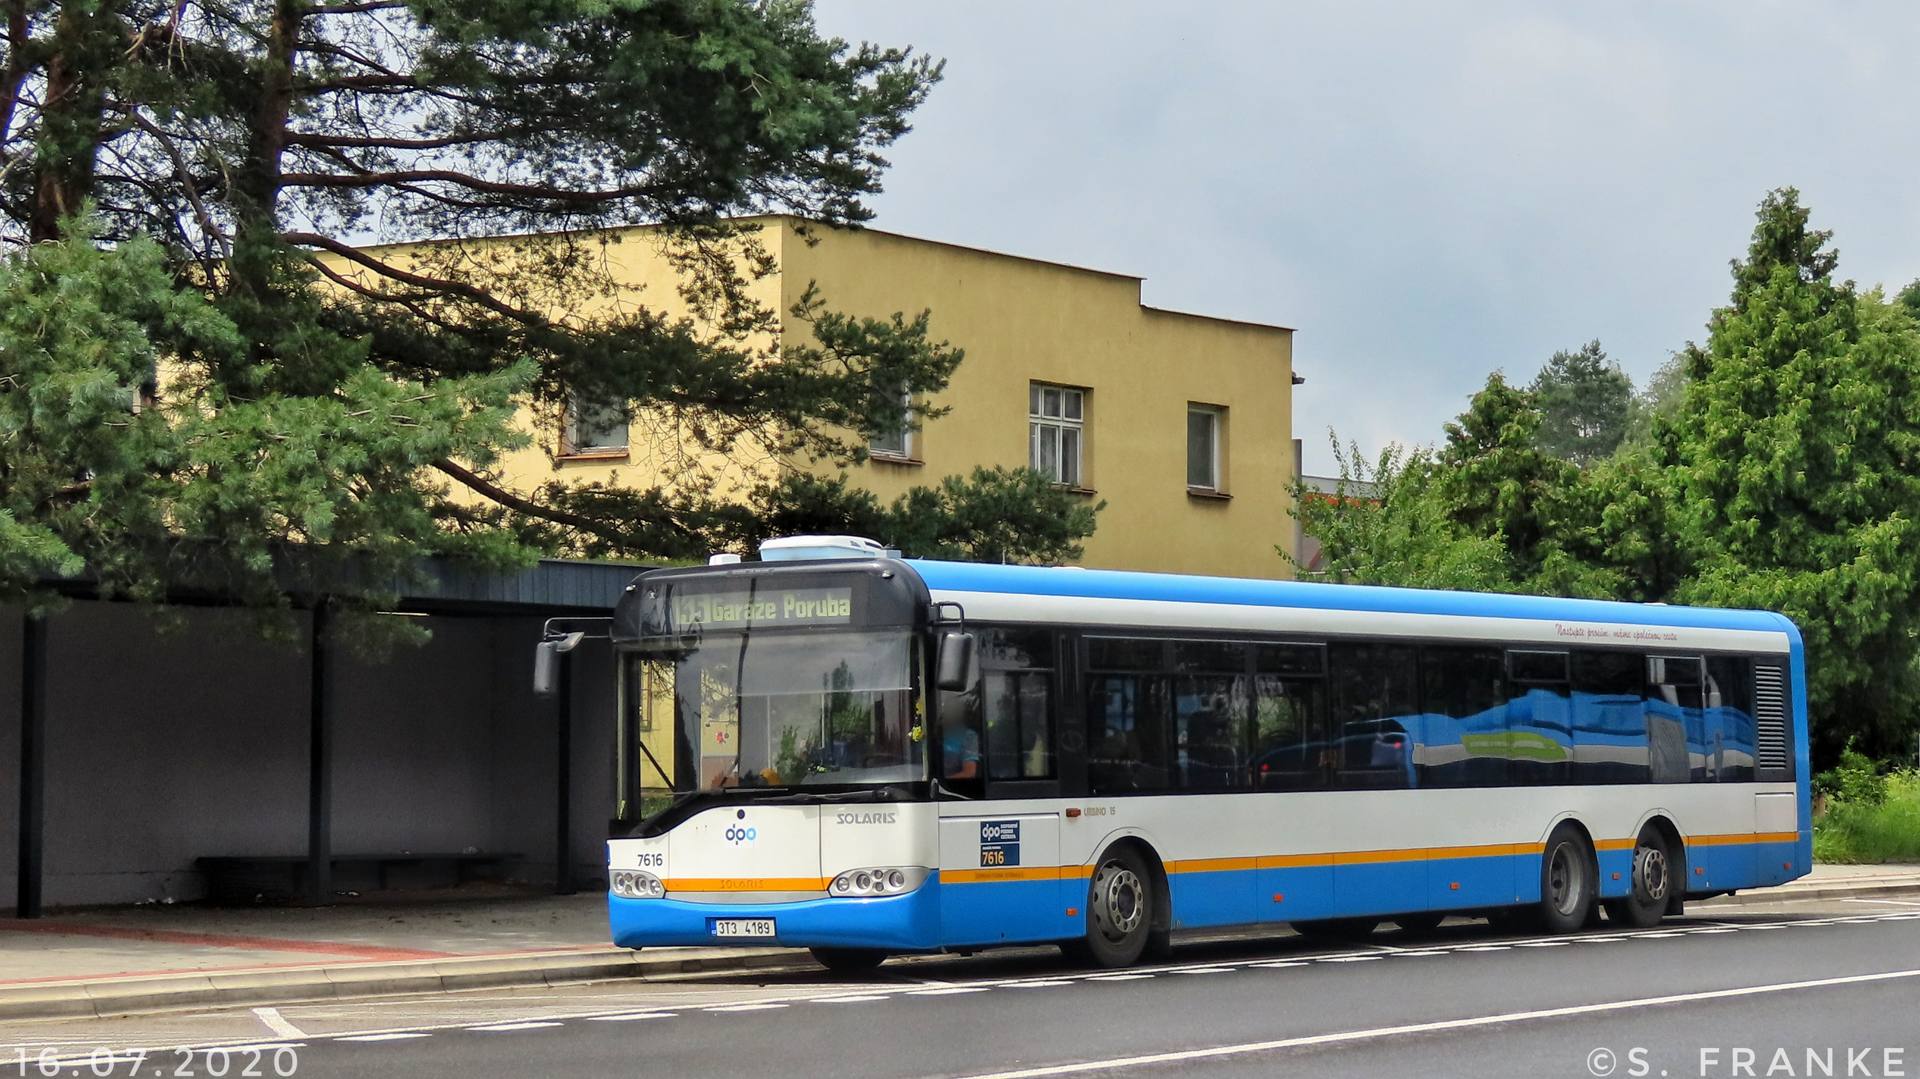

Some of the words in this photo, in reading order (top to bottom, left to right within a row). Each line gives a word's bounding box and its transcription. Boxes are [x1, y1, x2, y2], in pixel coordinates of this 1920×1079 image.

[783, 593, 851, 619] Poruba
[836, 812, 897, 825] SOLARIS
[725, 823, 757, 846] dpo
[982, 823, 1001, 842] dpo
[637, 853, 663, 867] 7616
[982, 851, 1005, 865] 7616
[718, 922, 738, 935] 3T3
[744, 922, 770, 935] 4189
